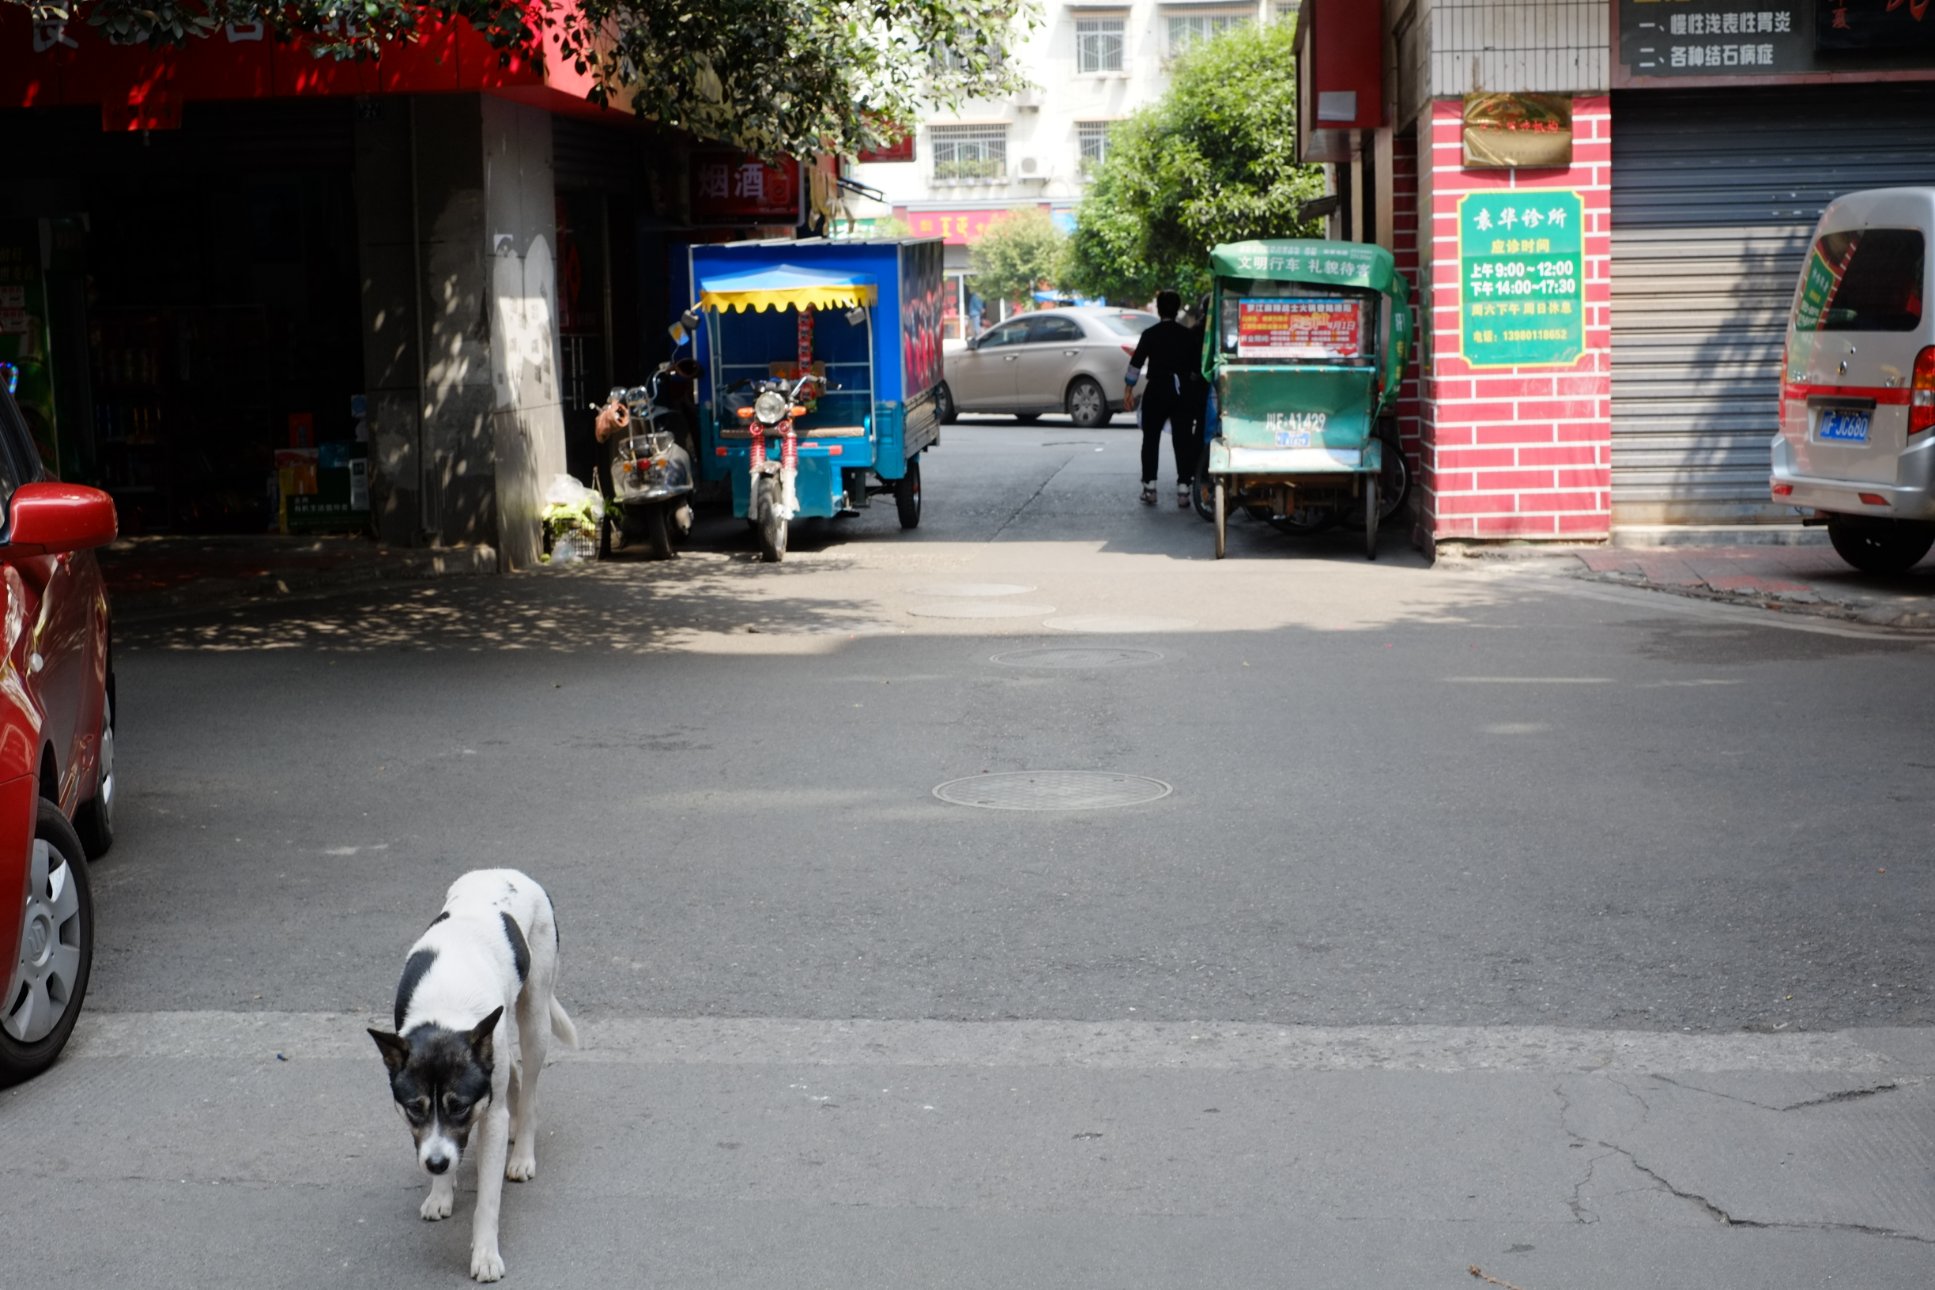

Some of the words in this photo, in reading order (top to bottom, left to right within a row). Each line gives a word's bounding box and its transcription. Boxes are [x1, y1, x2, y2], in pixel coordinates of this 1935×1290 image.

[1639, 11, 1791, 35] 一、慢性浅表性胃炎
[1639, 44, 1774, 68] 二、各种结石病症
[698, 163, 764, 199] 烟酒
[1491, 238, 1551, 254] 应诊时间
[1238, 256, 1299, 272] 文明行车
